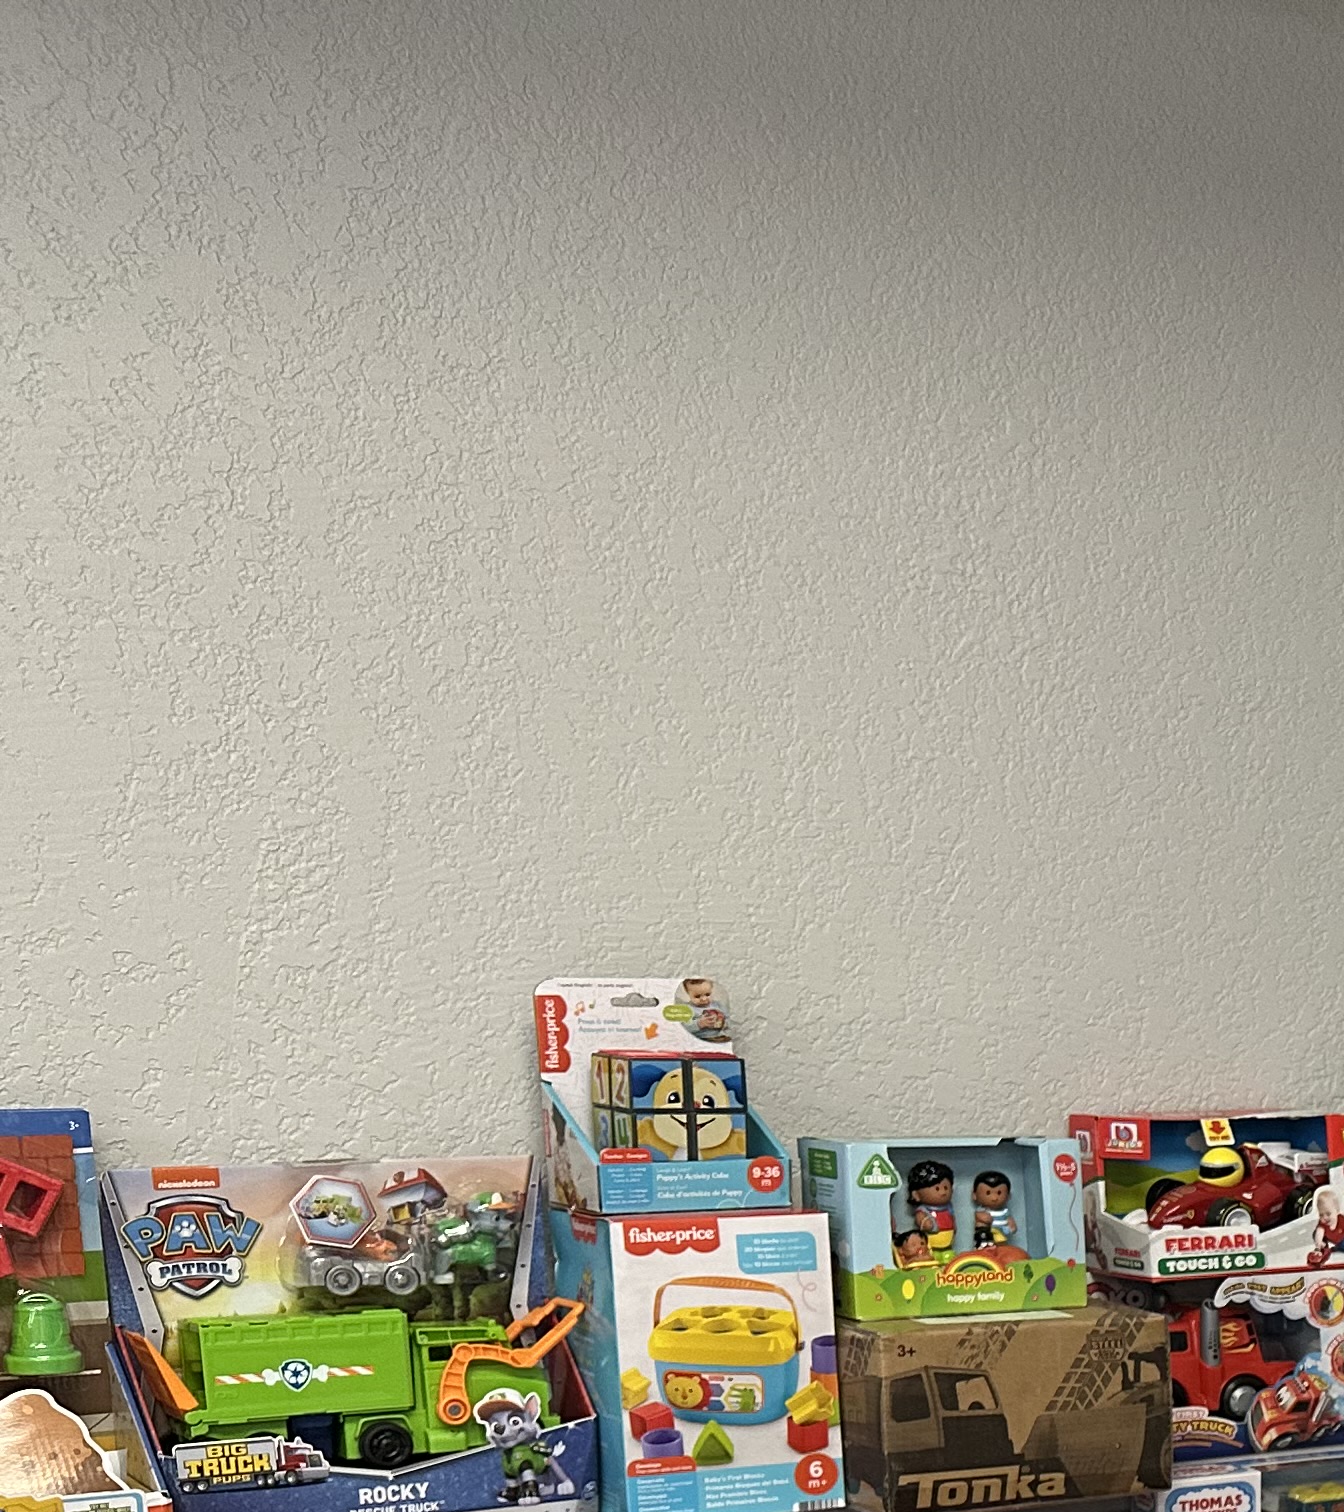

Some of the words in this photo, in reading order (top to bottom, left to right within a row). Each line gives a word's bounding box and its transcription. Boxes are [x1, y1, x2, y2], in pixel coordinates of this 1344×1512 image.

[543, 998, 560, 1070] fisher-price
[752, 1166, 780, 1178] 9-36
[121, 1211, 263, 1261] PAW
[628, 1226, 715, 1245] fisher-price
[1165, 1233, 1255, 1254] FERRARI
[158, 1262, 233, 1279] PATROL
[1166, 1258, 1219, 1273] TOUCH
[1221, 1257, 1231, 1270] &
[1234, 1255, 1258, 1268] GO
[936, 1269, 1014, 1287] happyland
[947, 1293, 976, 1304] happy
[978, 1292, 1005, 1303] family
[206, 1444, 249, 1458] BIG
[184, 1453, 273, 1479] TRUCK
[359, 1482, 430, 1505] ROCKY
[900, 1470, 1066, 1508] Tonka
[1178, 1494, 1243, 1512] THOMAS
